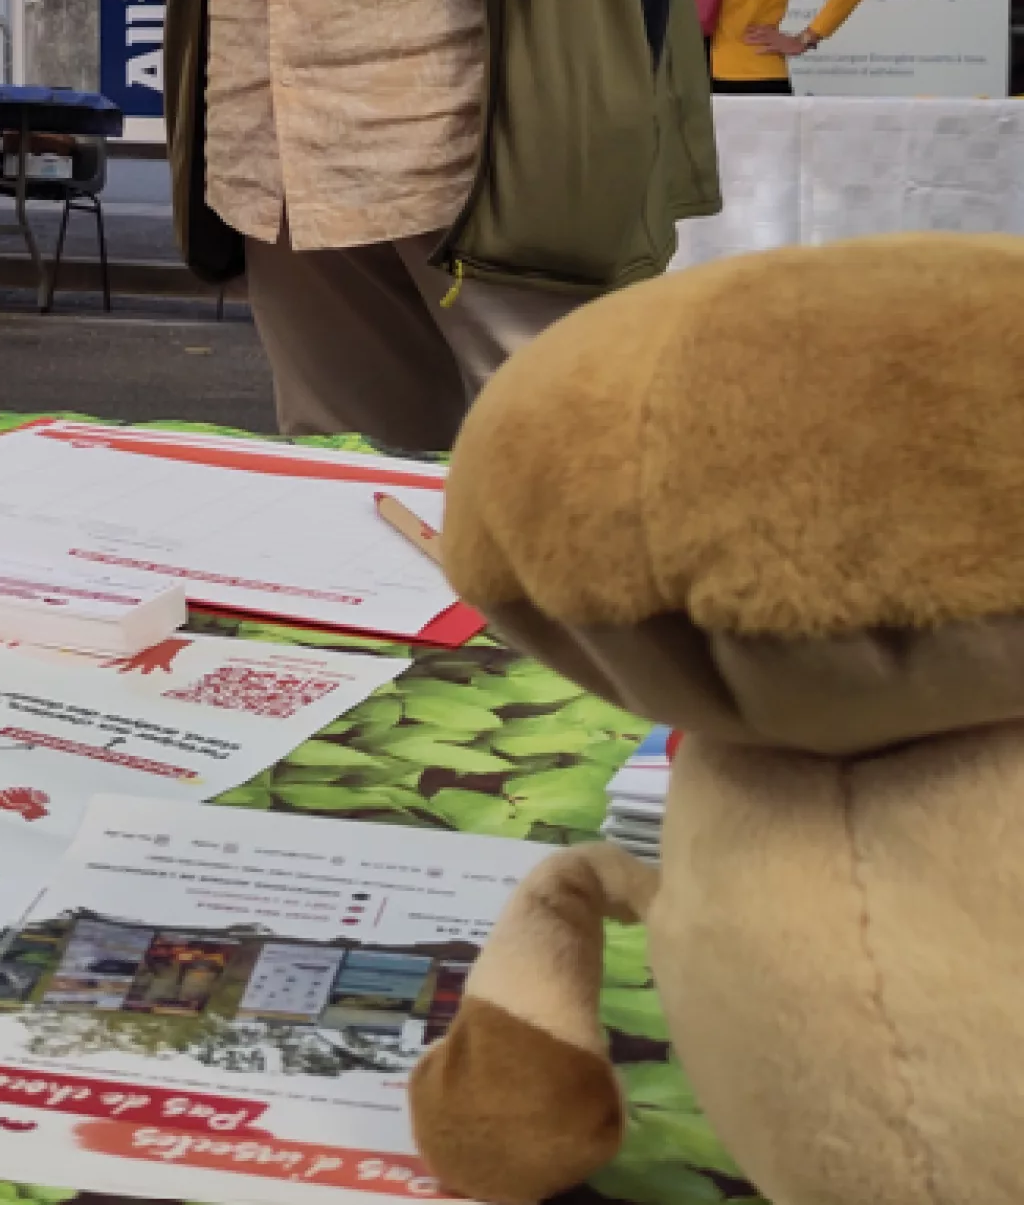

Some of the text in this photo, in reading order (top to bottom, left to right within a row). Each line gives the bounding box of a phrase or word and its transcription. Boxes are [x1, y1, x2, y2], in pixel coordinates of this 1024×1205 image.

[100, 1090, 152, 1116] de
[162, 1097, 245, 1131] Pas
[355, 1158, 439, 1195] Pas
